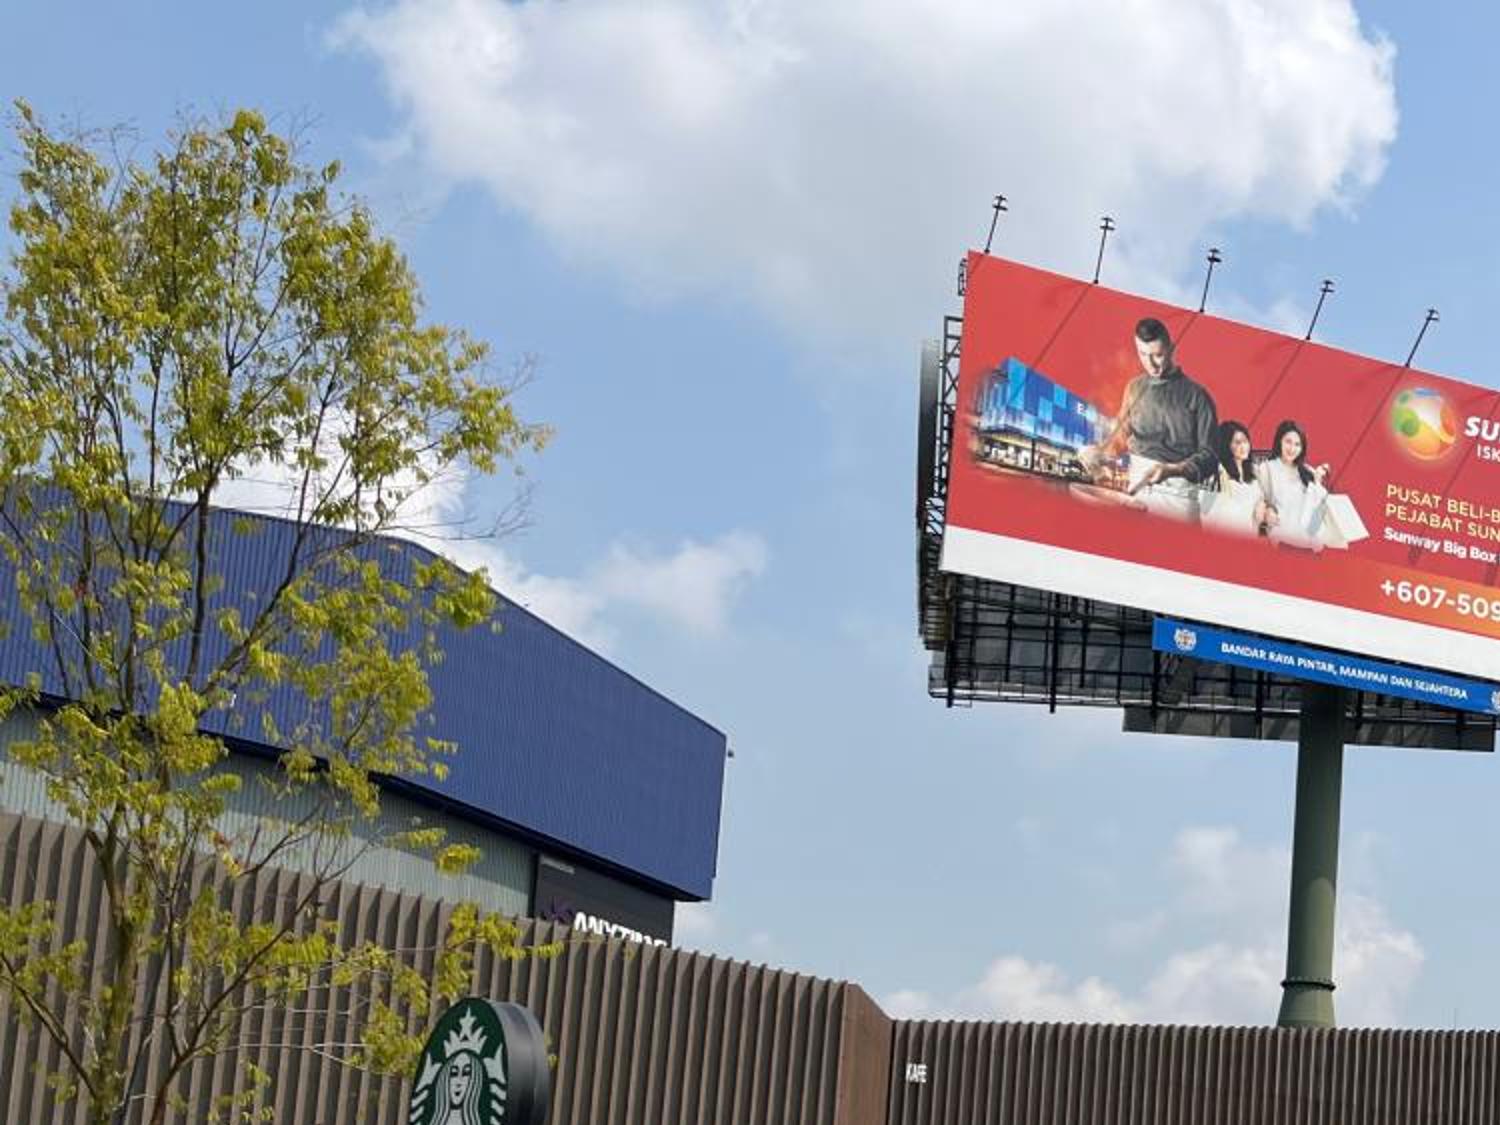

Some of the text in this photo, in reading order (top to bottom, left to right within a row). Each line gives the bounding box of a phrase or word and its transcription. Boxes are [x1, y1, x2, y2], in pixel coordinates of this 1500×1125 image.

[1386, 484, 1442, 509] PUSAT
[1385, 503, 1462, 533] PEJABAT
[1383, 527, 1441, 553] Sunway
[1443, 539, 1468, 560] Big
[1469, 546, 1497, 564] Box
[1221, 642, 1266, 661] BANDAR
[1390, 674, 1413, 688] DAN
